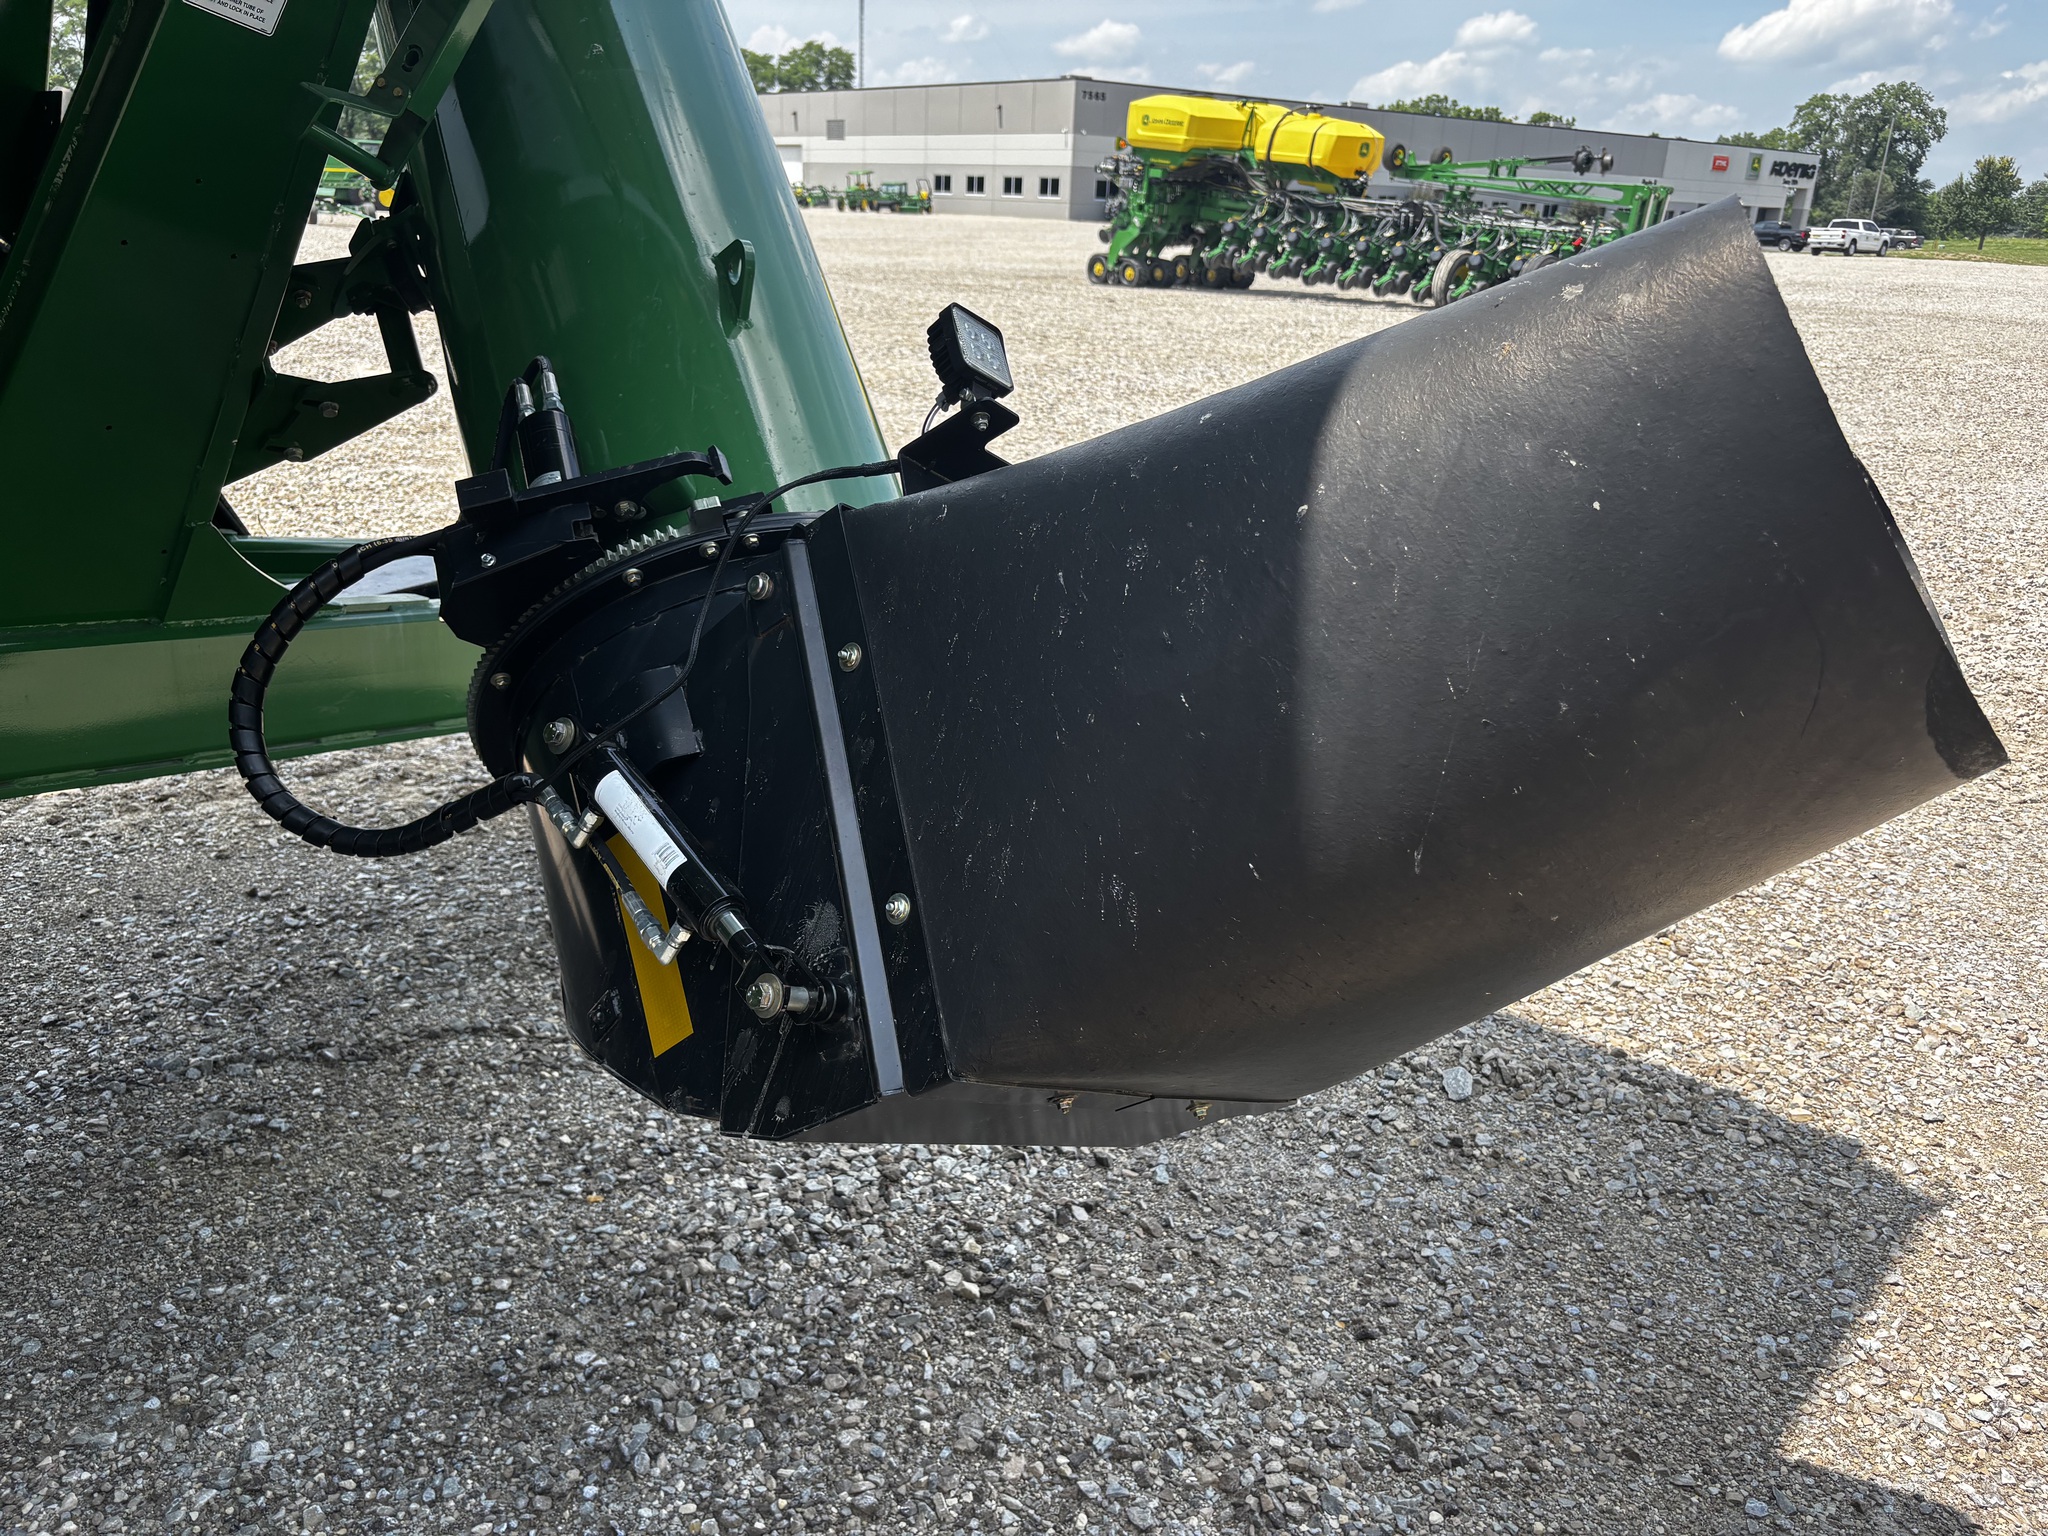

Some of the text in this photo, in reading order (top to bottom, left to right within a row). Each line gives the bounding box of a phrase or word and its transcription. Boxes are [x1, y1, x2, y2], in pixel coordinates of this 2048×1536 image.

[217, 0, 229, 8] AND
[229, 4, 243, 14] LOCK
[249, 12, 266, 23] PLACE
[243, 2, 256, 12] TUBE
